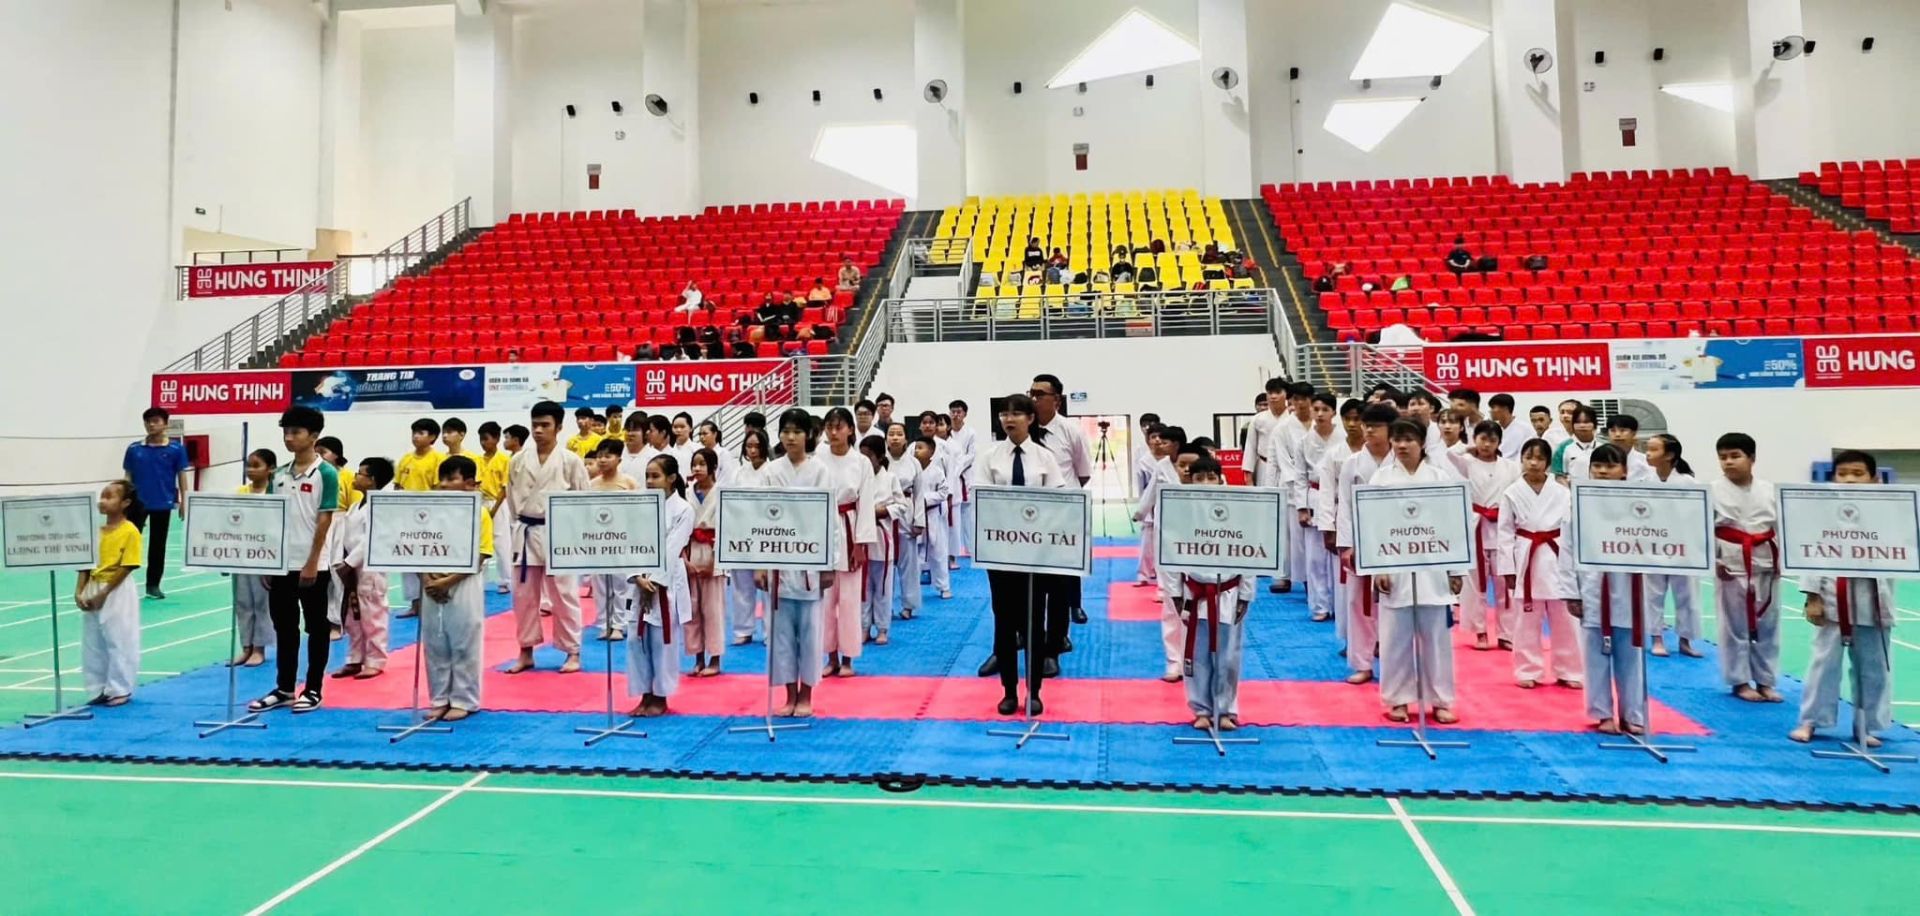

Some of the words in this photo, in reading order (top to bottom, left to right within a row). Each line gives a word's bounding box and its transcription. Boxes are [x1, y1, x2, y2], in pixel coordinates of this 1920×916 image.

[1532, 356, 1601, 382] THỊNH
[233, 383, 284, 405] THỊNH
[245, 534, 266, 542] THCS
[729, 538, 754, 552] MỸ
[984, 529, 1043, 544] TRỌNG
[1048, 531, 1077, 546] TÀI
[392, 544, 414, 556] AN
[1378, 542, 1401, 556] AN
[1851, 545, 1907, 562] ĐỊNH
